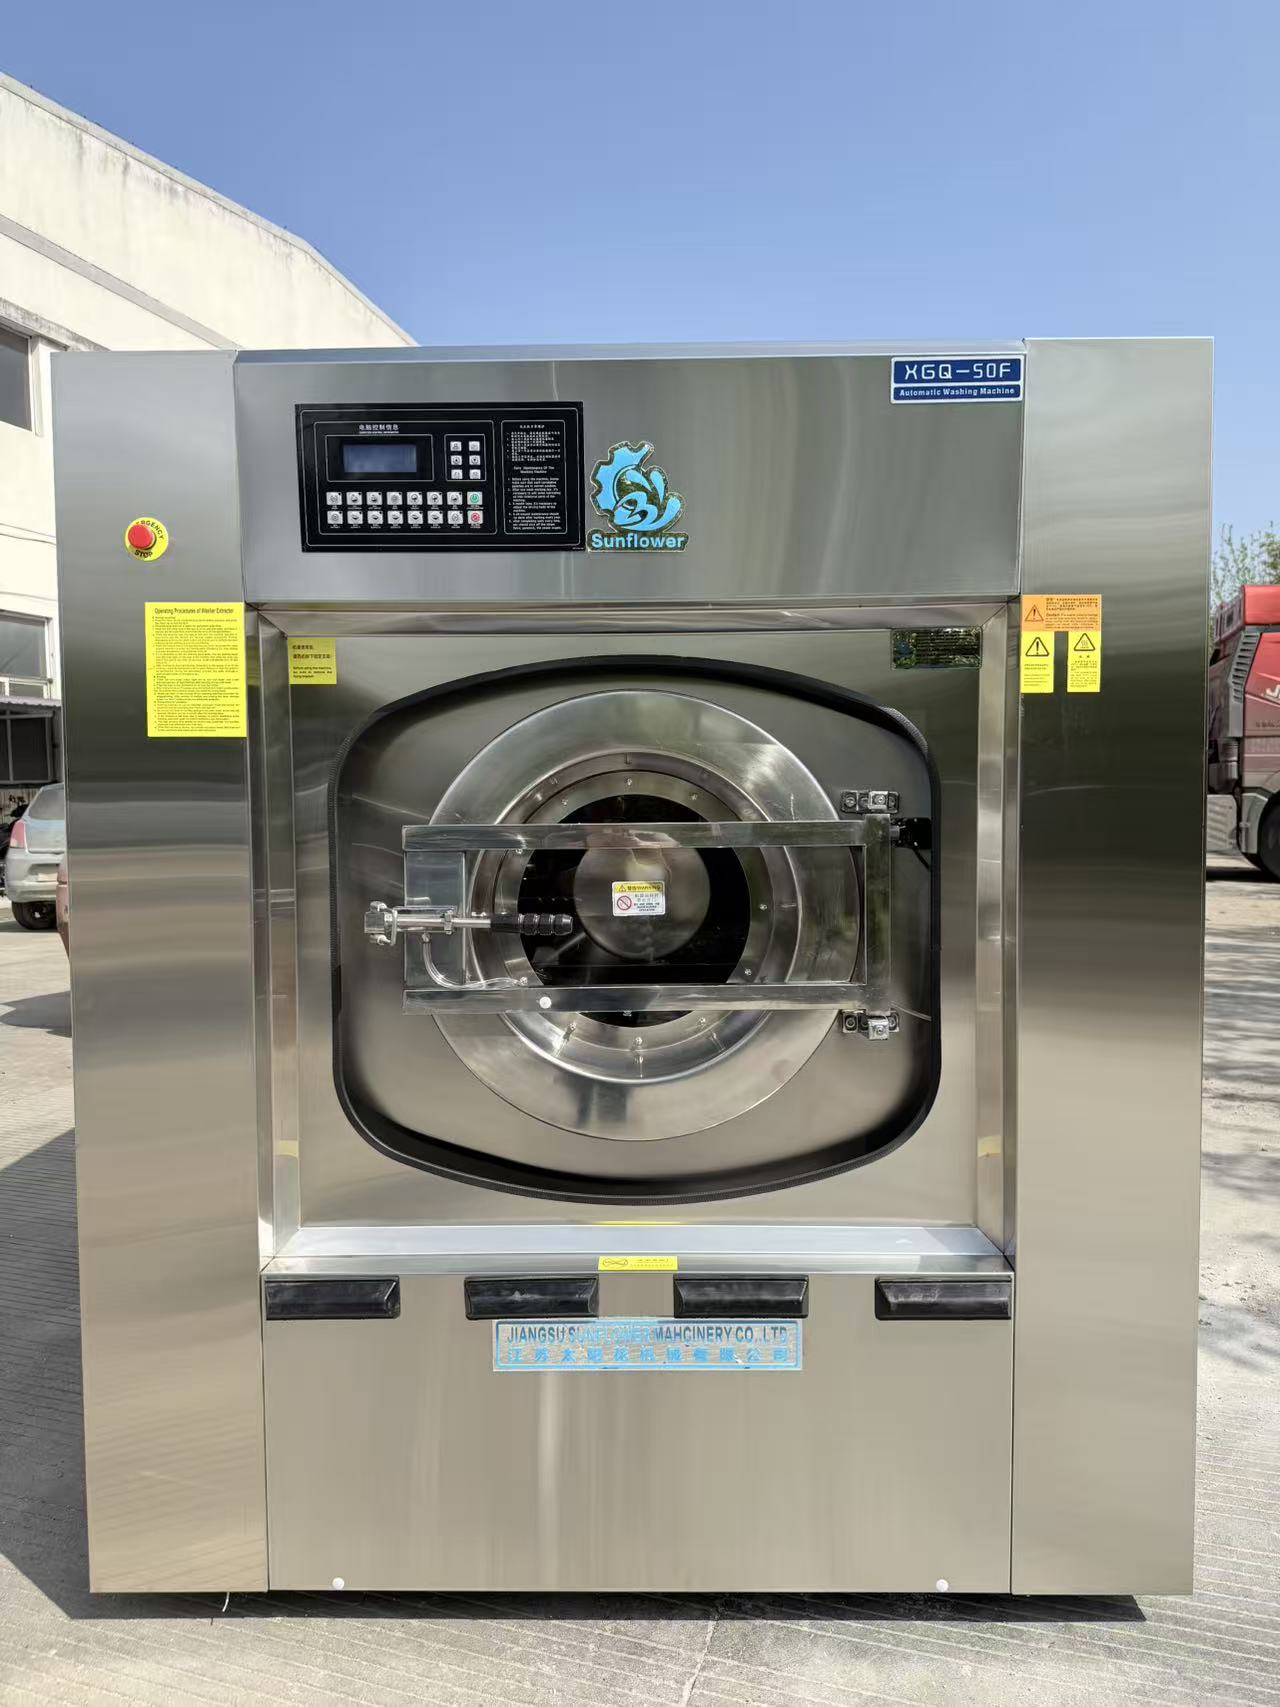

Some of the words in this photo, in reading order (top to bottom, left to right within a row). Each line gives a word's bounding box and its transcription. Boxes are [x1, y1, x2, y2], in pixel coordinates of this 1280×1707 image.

[904, 362, 1011, 380] XGQ-50F
[899, 388, 941, 397] Automatic
[942, 387, 978, 397] Washing
[979, 387, 1015, 395] Machine
[591, 532, 686, 548] Sunflower
[134, 549, 153, 559] STOP
[507, 1326, 564, 1344] JIANGSU
